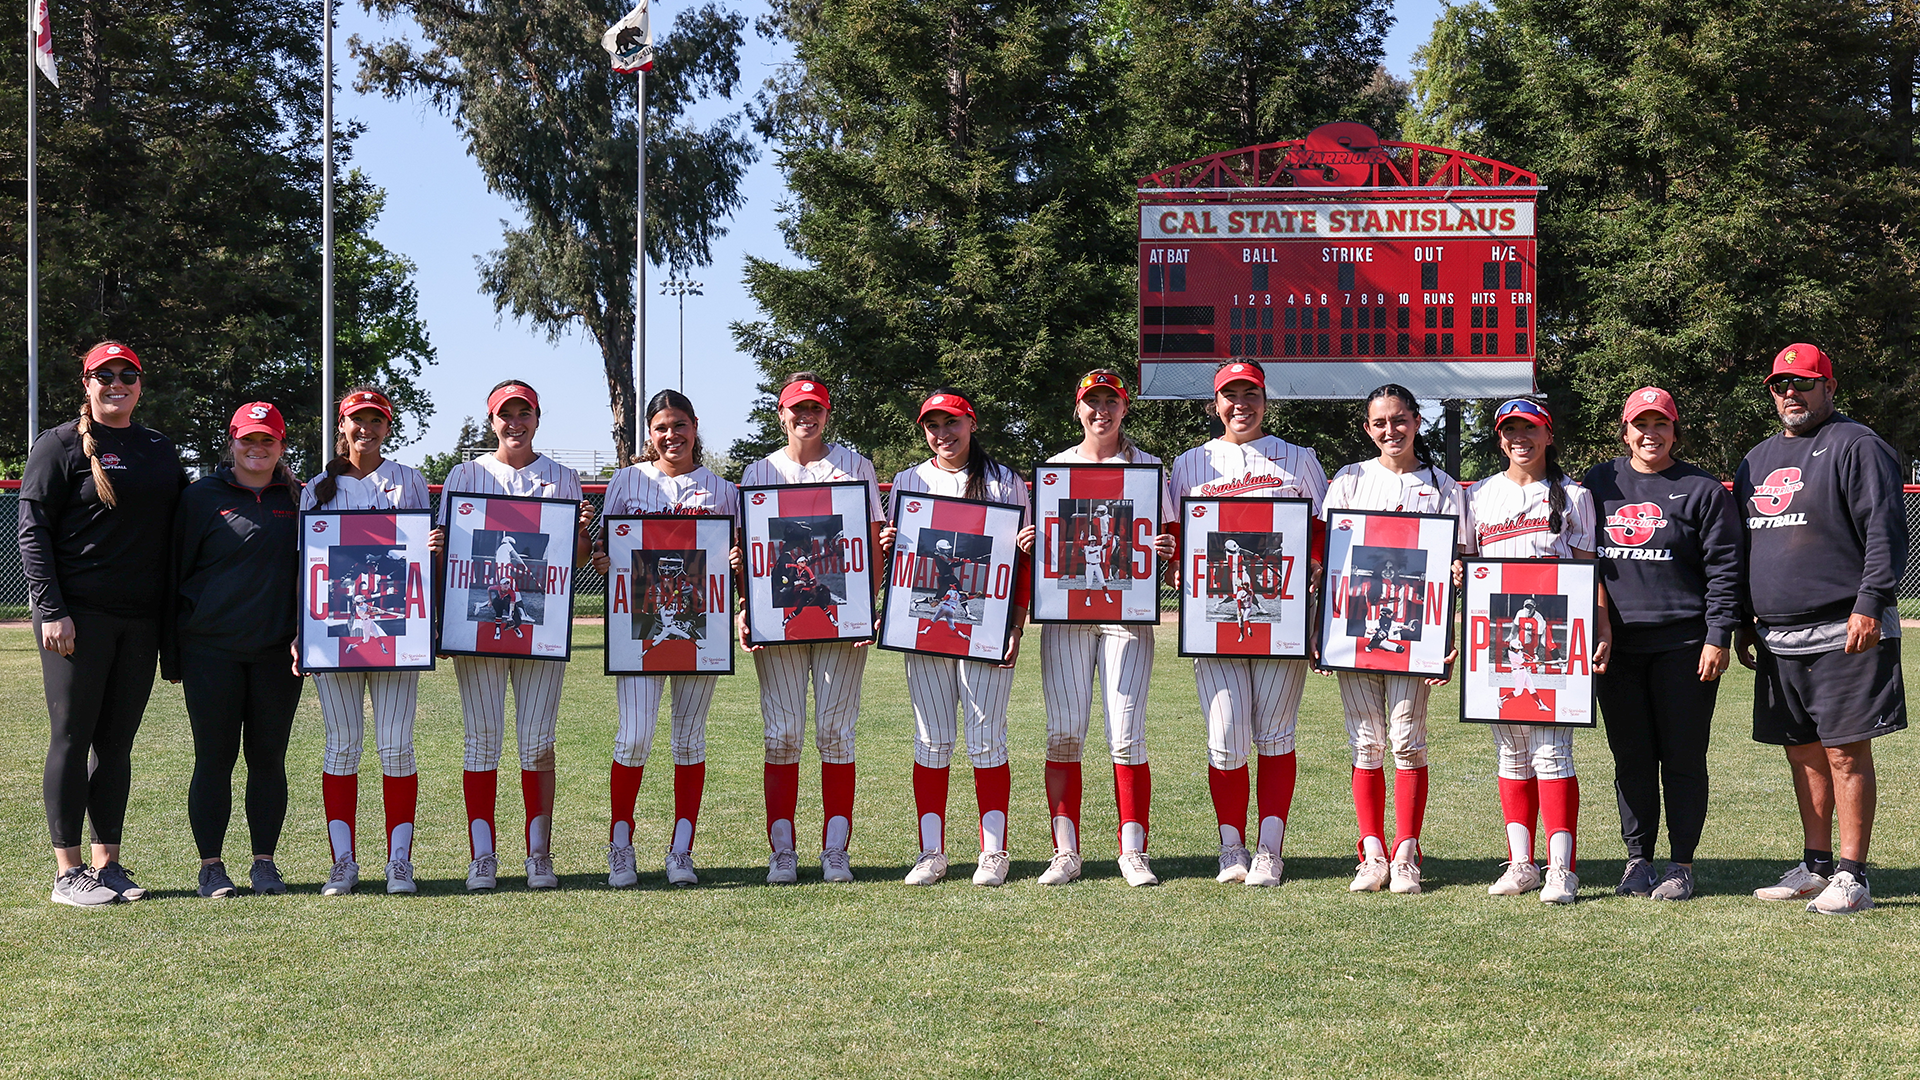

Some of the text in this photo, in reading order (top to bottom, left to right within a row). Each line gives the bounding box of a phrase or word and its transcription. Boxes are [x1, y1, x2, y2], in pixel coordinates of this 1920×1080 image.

[1283, 121, 1380, 197] S
[1287, 150, 1389, 165] WARRIORS
[1159, 208, 1516, 234] CAL STATE STANISLAUS
[1149, 248, 1190, 264] AT BAT
[1242, 247, 1278, 263] BALL
[1322, 247, 1374, 263] STRIKE
[1414, 246, 1444, 262] OUT
[1491, 245, 1517, 261] H/E
[1233, 294, 1238, 306] 1
[1248, 294, 1255, 306] 2
[1264, 294, 1271, 306] 3
[1287, 293, 1295, 305] 4
[1304, 293, 1311, 305] 5
[1320, 293, 1328, 305] 6
[1344, 293, 1351, 305] 7
[1361, 293, 1368, 305] 8
[1377, 293, 1384, 305] 9
[1398, 292, 1409, 305] 10
[1423, 292, 1454, 305] RUNS
[1471, 292, 1496, 305] HITS
[1511, 292, 1532, 304] ERR
[247, 406, 269, 419] S
[1200, 471, 1274, 498] Stanislaus
[1750, 466, 1801, 516] S
[1754, 482, 1804, 495] WARRIORS
[1478, 512, 1550, 538] Stanislaus
[1604, 502, 1663, 547] S
[1606, 516, 1668, 528] WARRIORS
[1746, 512, 1808, 530] SOFTBALL
[1044, 516, 1153, 580] DAVIS
[1597, 546, 1674, 561] SOFTBALL
[892, 551, 1011, 600] MARELLO
[1470, 616, 1590, 675] PEREA
